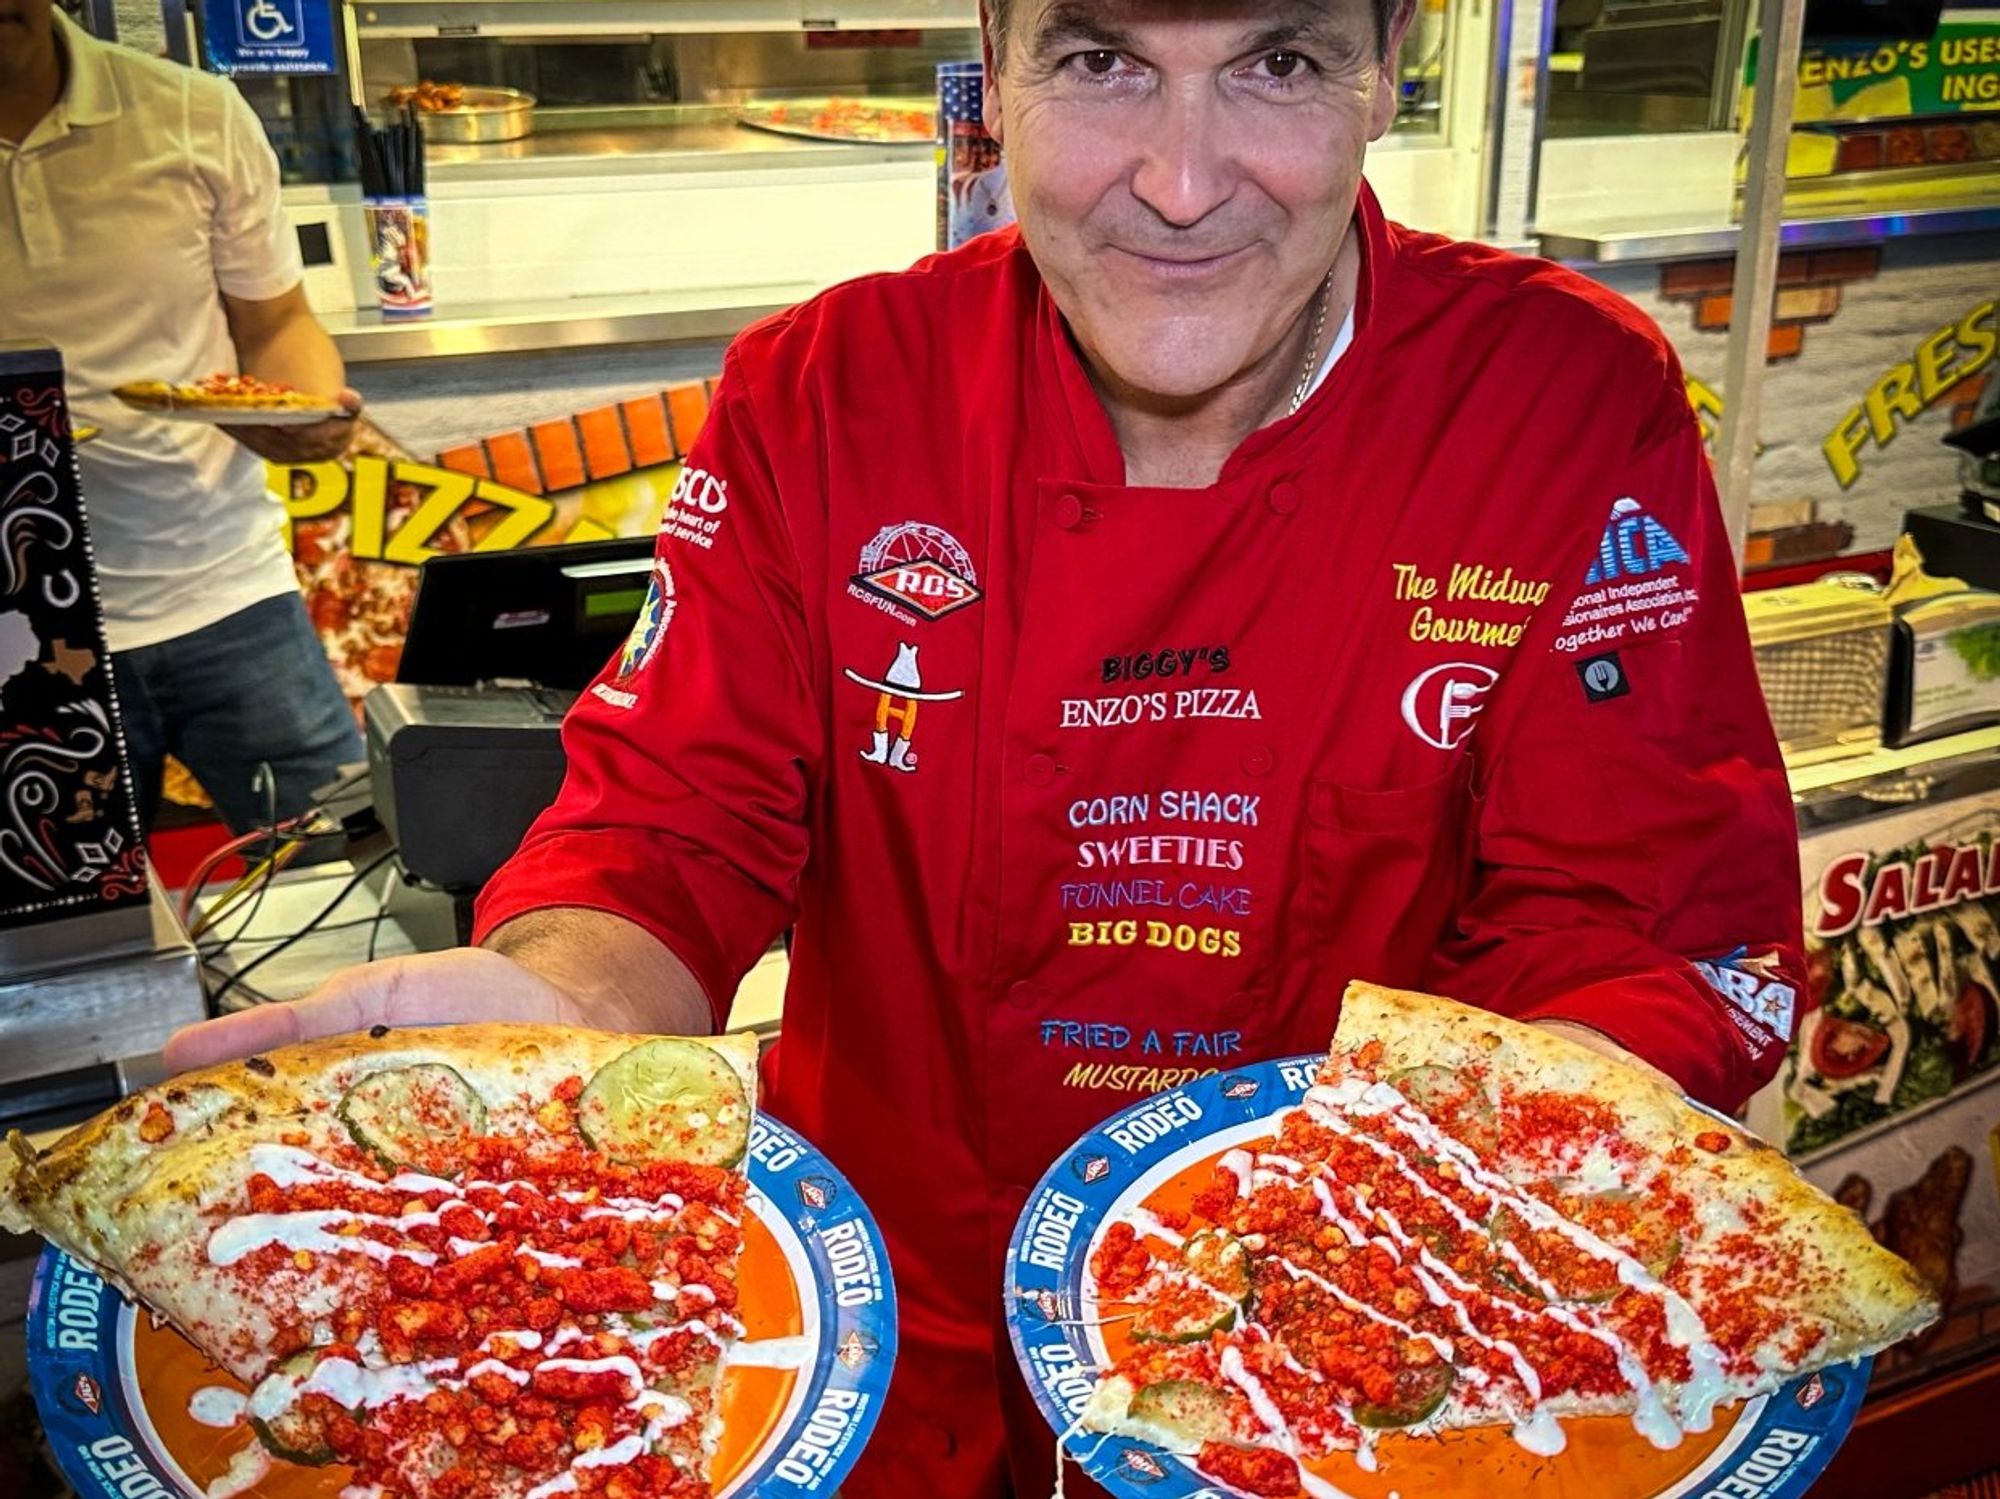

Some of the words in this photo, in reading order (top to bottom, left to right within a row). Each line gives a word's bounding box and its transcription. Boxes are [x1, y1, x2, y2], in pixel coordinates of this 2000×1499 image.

[276, 48, 309, 59] happy
[1940, 37, 2000, 66] USE
[1942, 73, 2000, 101] ING
[1822, 301, 1998, 490] FRES
[672, 467, 728, 513] SCO
[264, 456, 616, 565] PIZZ
[703, 520, 721, 534] of
[674, 527, 713, 549] service
[895, 569, 966, 598] RCS
[1393, 563, 1438, 600] The
[1447, 563, 1553, 606] Midwa
[1607, 576, 1678, 600] Independent
[1409, 606, 1531, 647] Gourme
[1549, 623, 1627, 652] ogether
[1630, 615, 1657, 634] We
[1562, 604, 1625, 627] sionaires
[1060, 692, 1167, 727] ENZO'S
[1173, 688, 1262, 719] PIZZA
[1069, 794, 1149, 828] CORN
[1159, 791, 1261, 826] SHACK
[1077, 836, 1244, 870] SWEETIES
[1060, 879, 1173, 909] FUNNEL
[1178, 882, 1252, 916] CAKE
[1068, 920, 1138, 946] BIG
[1146, 920, 1241, 957] DOGS
[1040, 1021, 1131, 1048] FRIED
[1143, 1034, 1162, 1055] A
[1173, 1030, 1242, 1056] FAIR
[1109, 1096, 1203, 1154] RODEO
[751, 1125, 799, 1173] DEO
[1030, 1191, 1085, 1272] RODEO
[820, 1221, 874, 1307] RODEO
[1040, 1343, 1095, 1416] ODEO
[774, 1388, 860, 1485] RODEO
[91, 1434, 180, 1499] DEO
